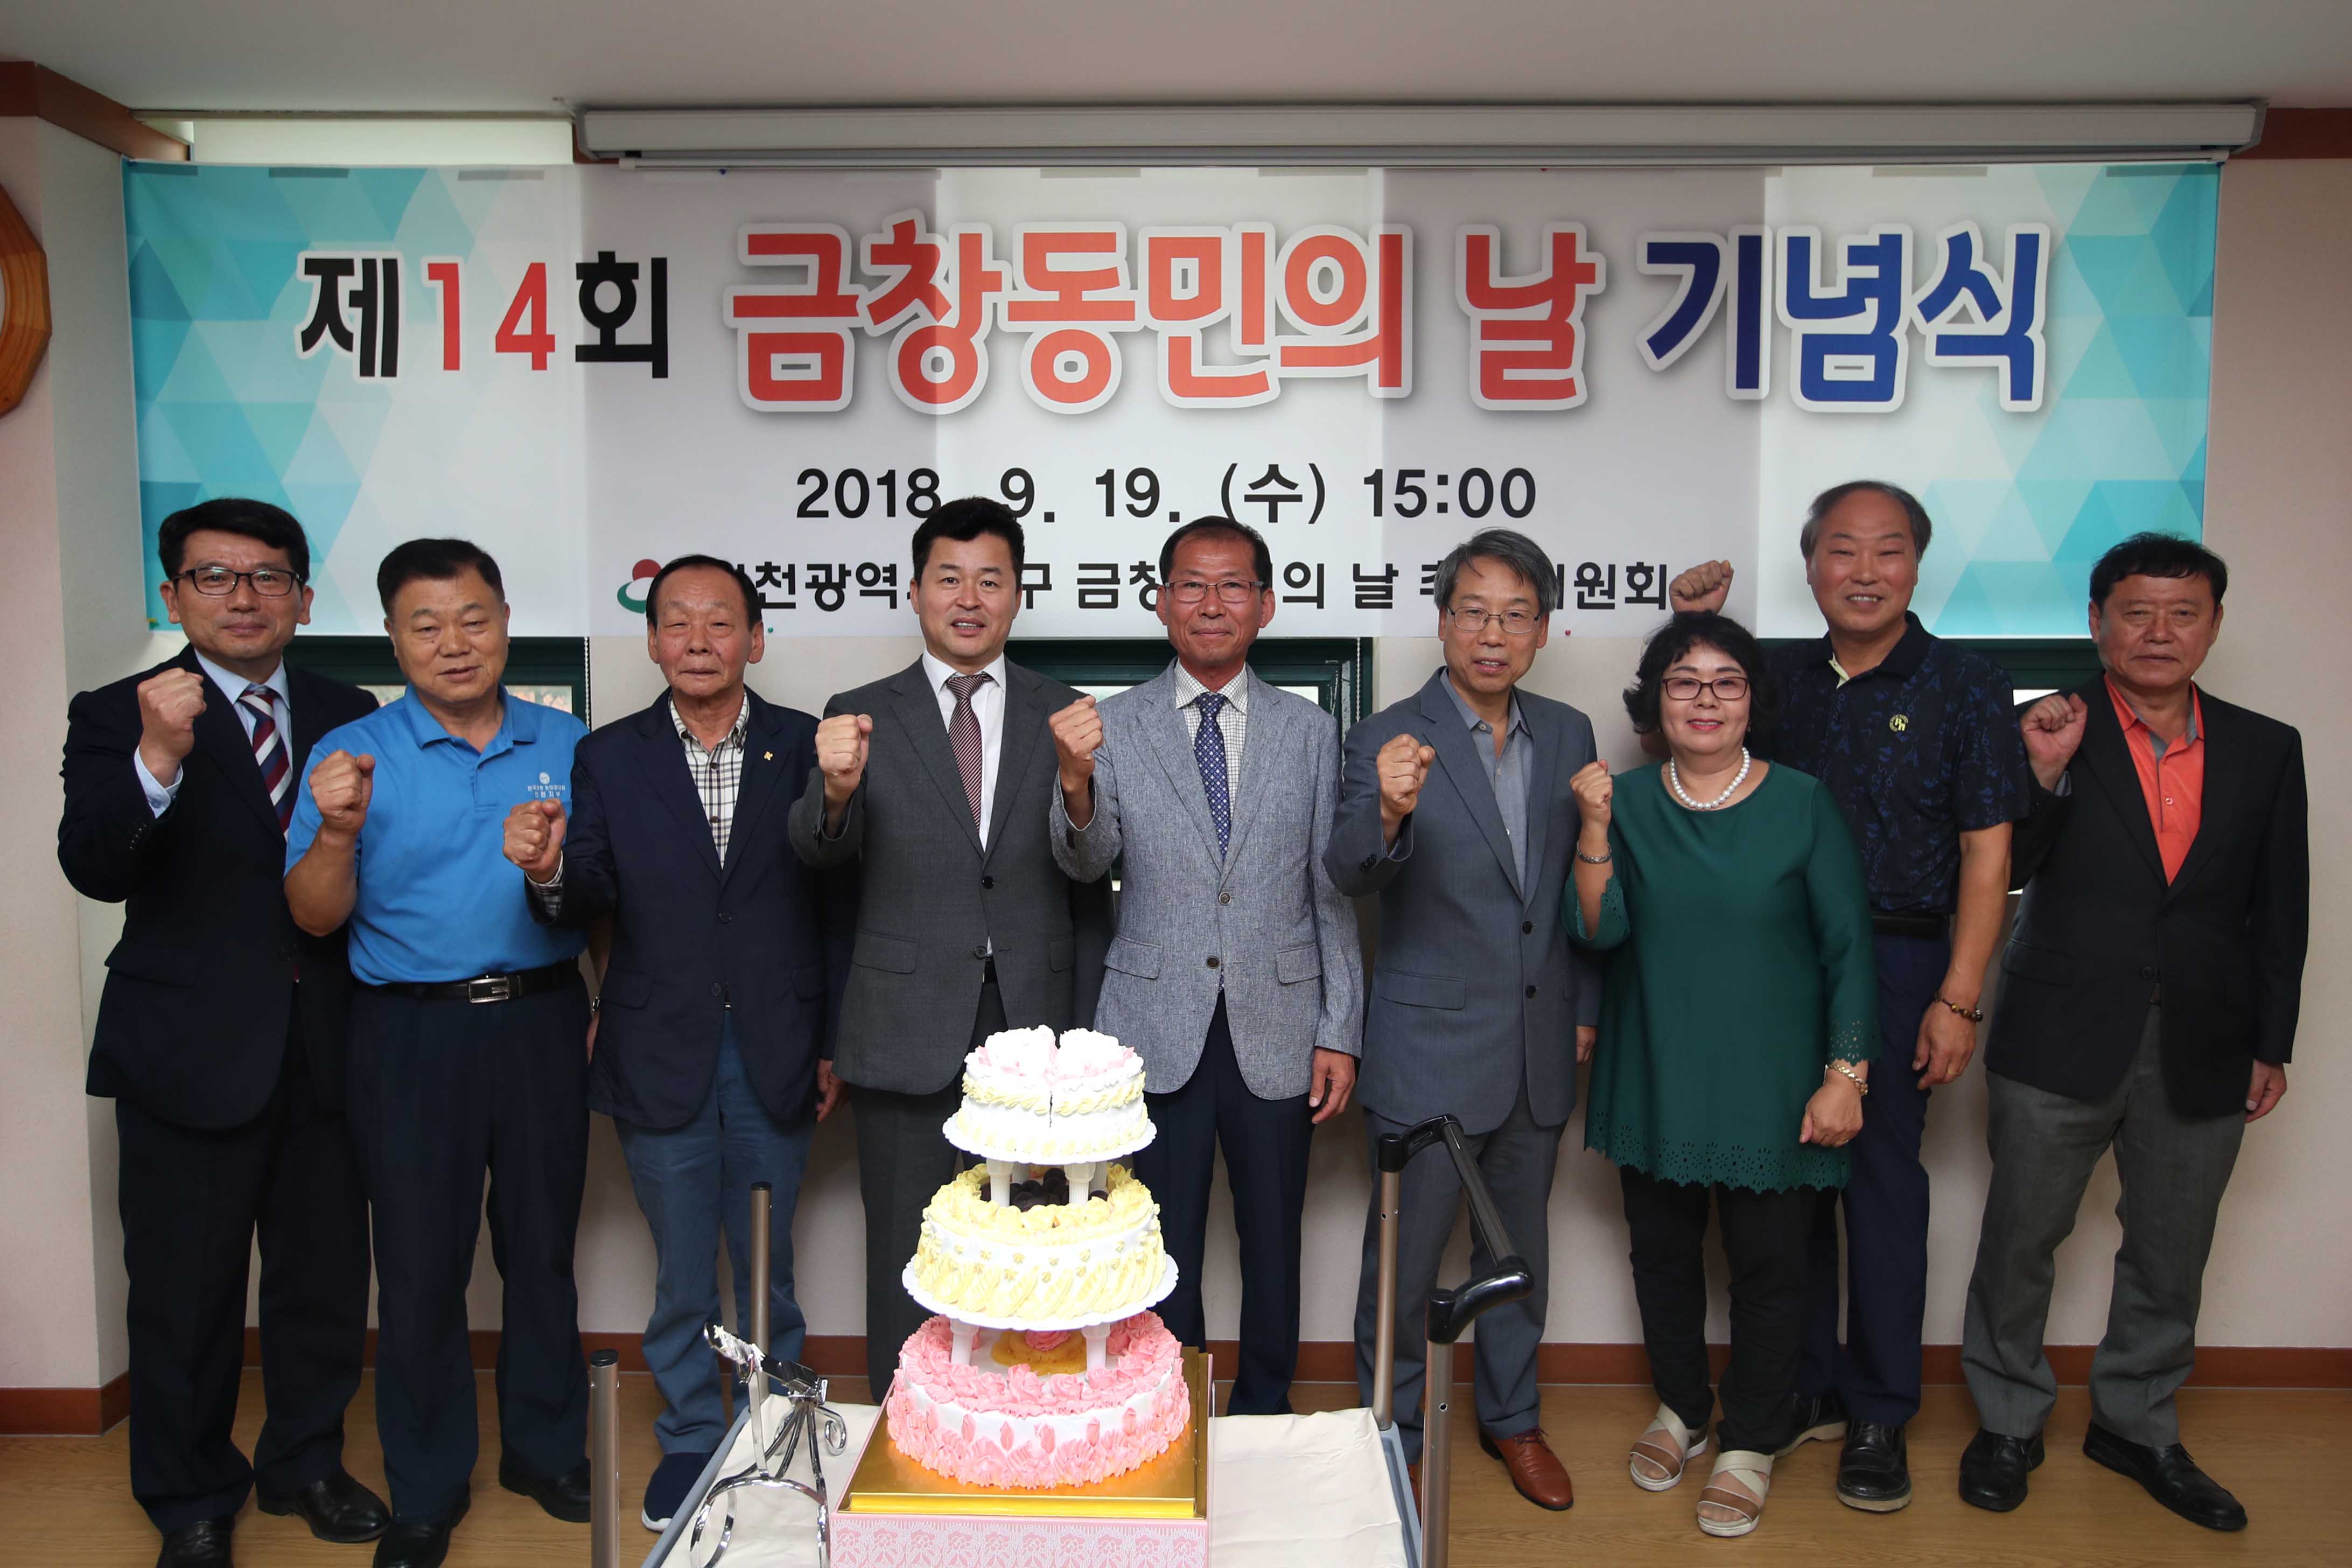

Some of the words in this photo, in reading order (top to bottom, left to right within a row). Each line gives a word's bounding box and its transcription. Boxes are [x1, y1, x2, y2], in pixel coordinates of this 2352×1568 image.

[300, 251, 669, 379] 제14회
[732, 218, 1403, 405] 금창동민의
[1465, 232, 1597, 401] 날
[1646, 232, 2039, 403] 기념식
[999, 467, 1055, 523] 9.
[1095, 467, 1181, 522] 19.
[1220, 463, 1326, 524] (수)
[1363, 467, 1536, 518] 15:00
[736, 562, 912, 612] 천광역
[1076, 561, 1325, 611] 금창의
[1352, 563, 1399, 609] 날
